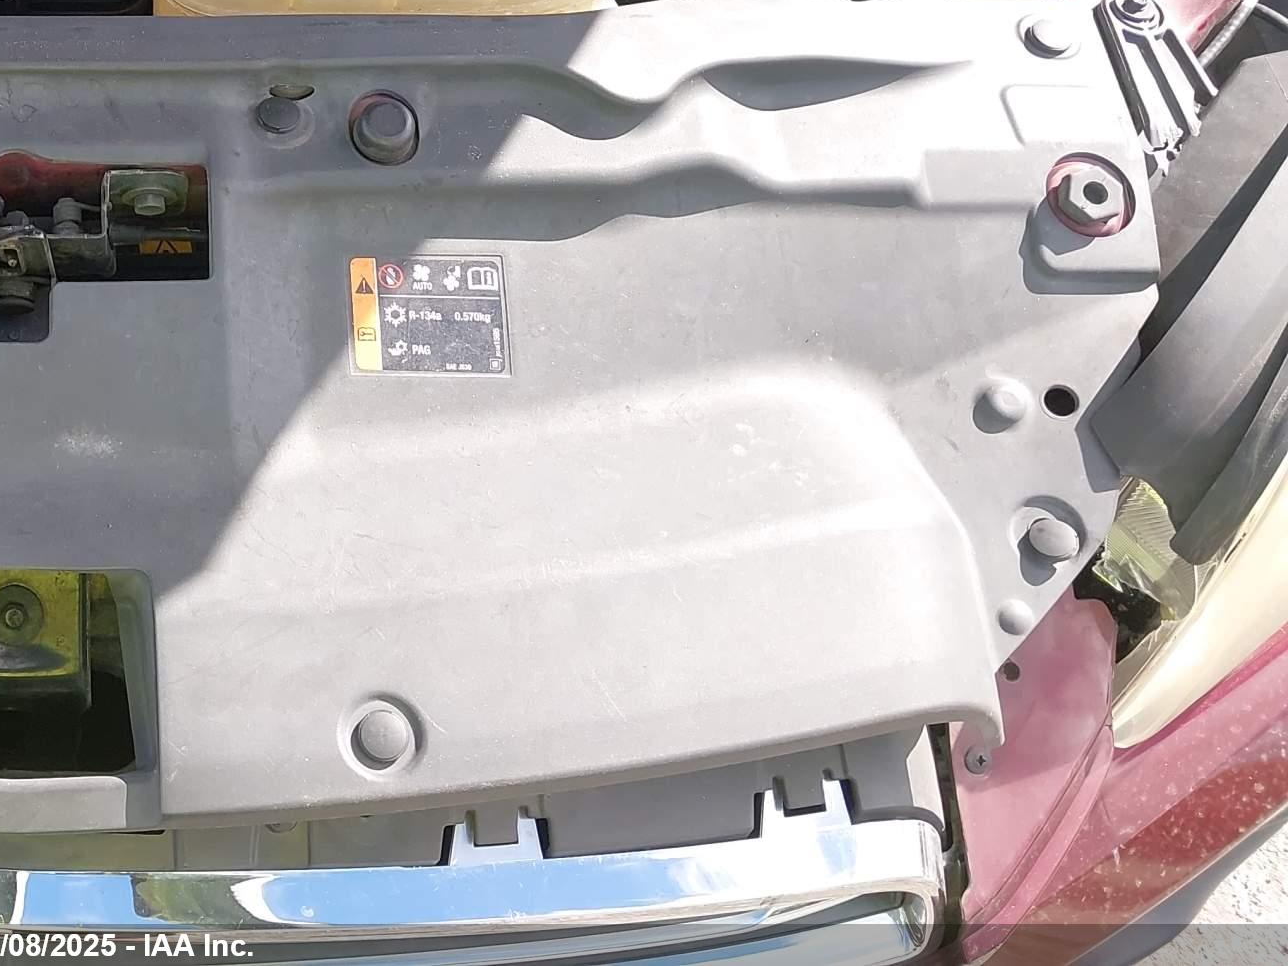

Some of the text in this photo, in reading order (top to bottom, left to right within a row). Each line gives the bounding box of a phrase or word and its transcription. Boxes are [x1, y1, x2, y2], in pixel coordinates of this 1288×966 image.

[413, 282, 433, 291] AUTO
[408, 310, 492, 323] R-134a 0.570kg
[412, 344, 432, 355] PAG
